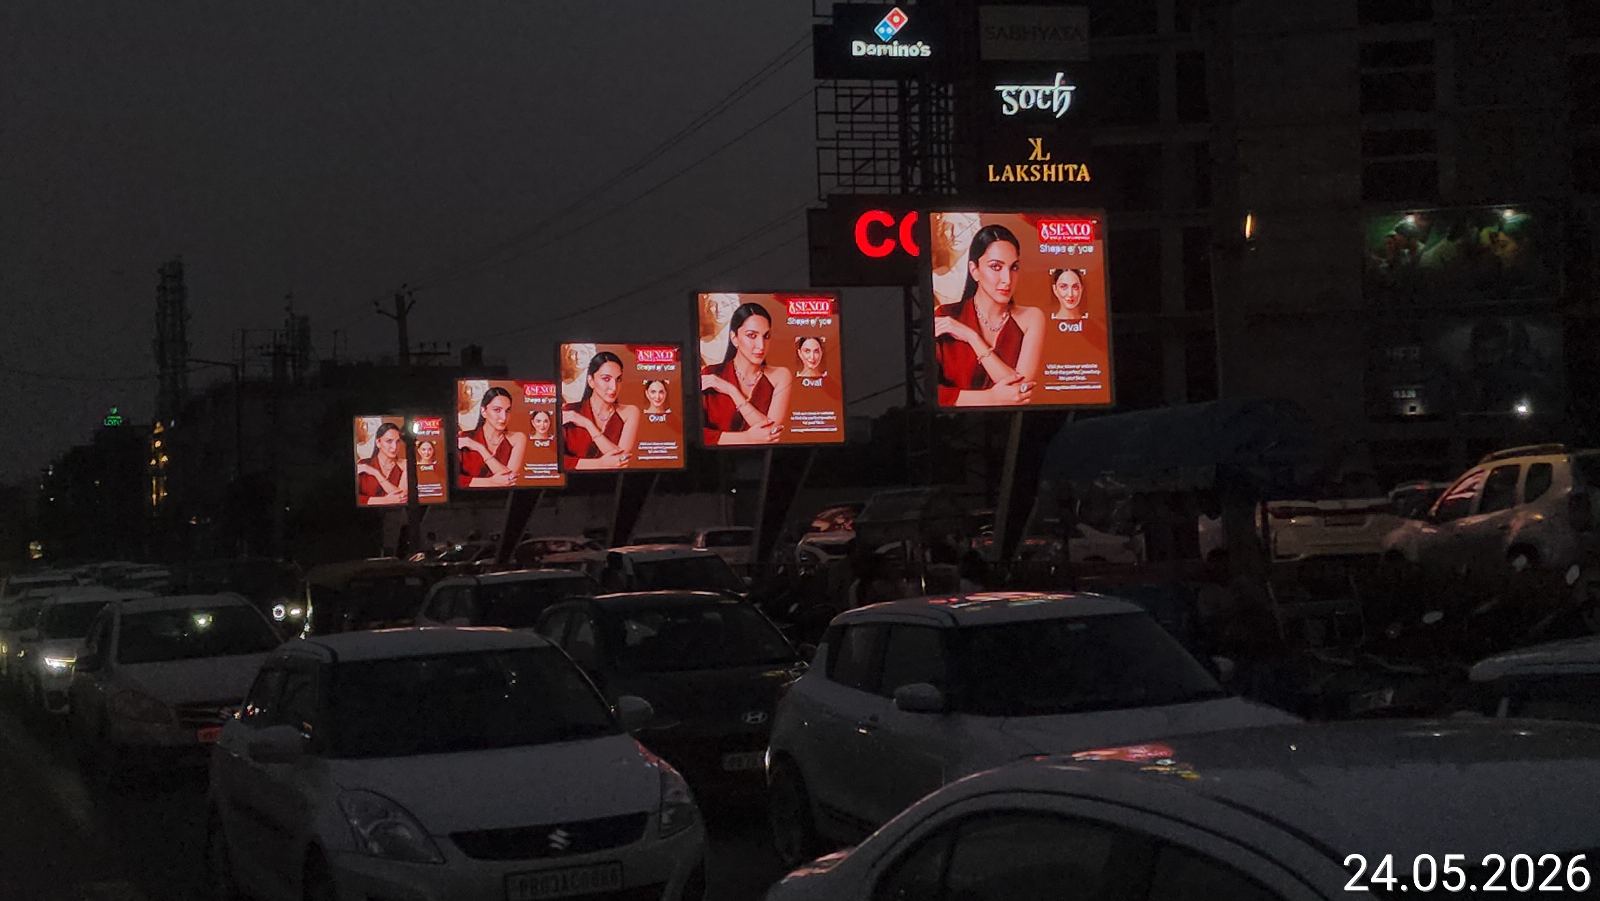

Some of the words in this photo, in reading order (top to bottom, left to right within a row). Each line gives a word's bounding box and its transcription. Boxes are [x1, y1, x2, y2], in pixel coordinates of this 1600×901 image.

[984, 24, 1085, 41] SABHYATA
[851, 40, 932, 57] Domino's
[987, 163, 1092, 183] LAKSHITA
[1048, 223, 1091, 236] SENCO
[1058, 320, 1083, 332] Oval
[802, 378, 823, 387] Oval
